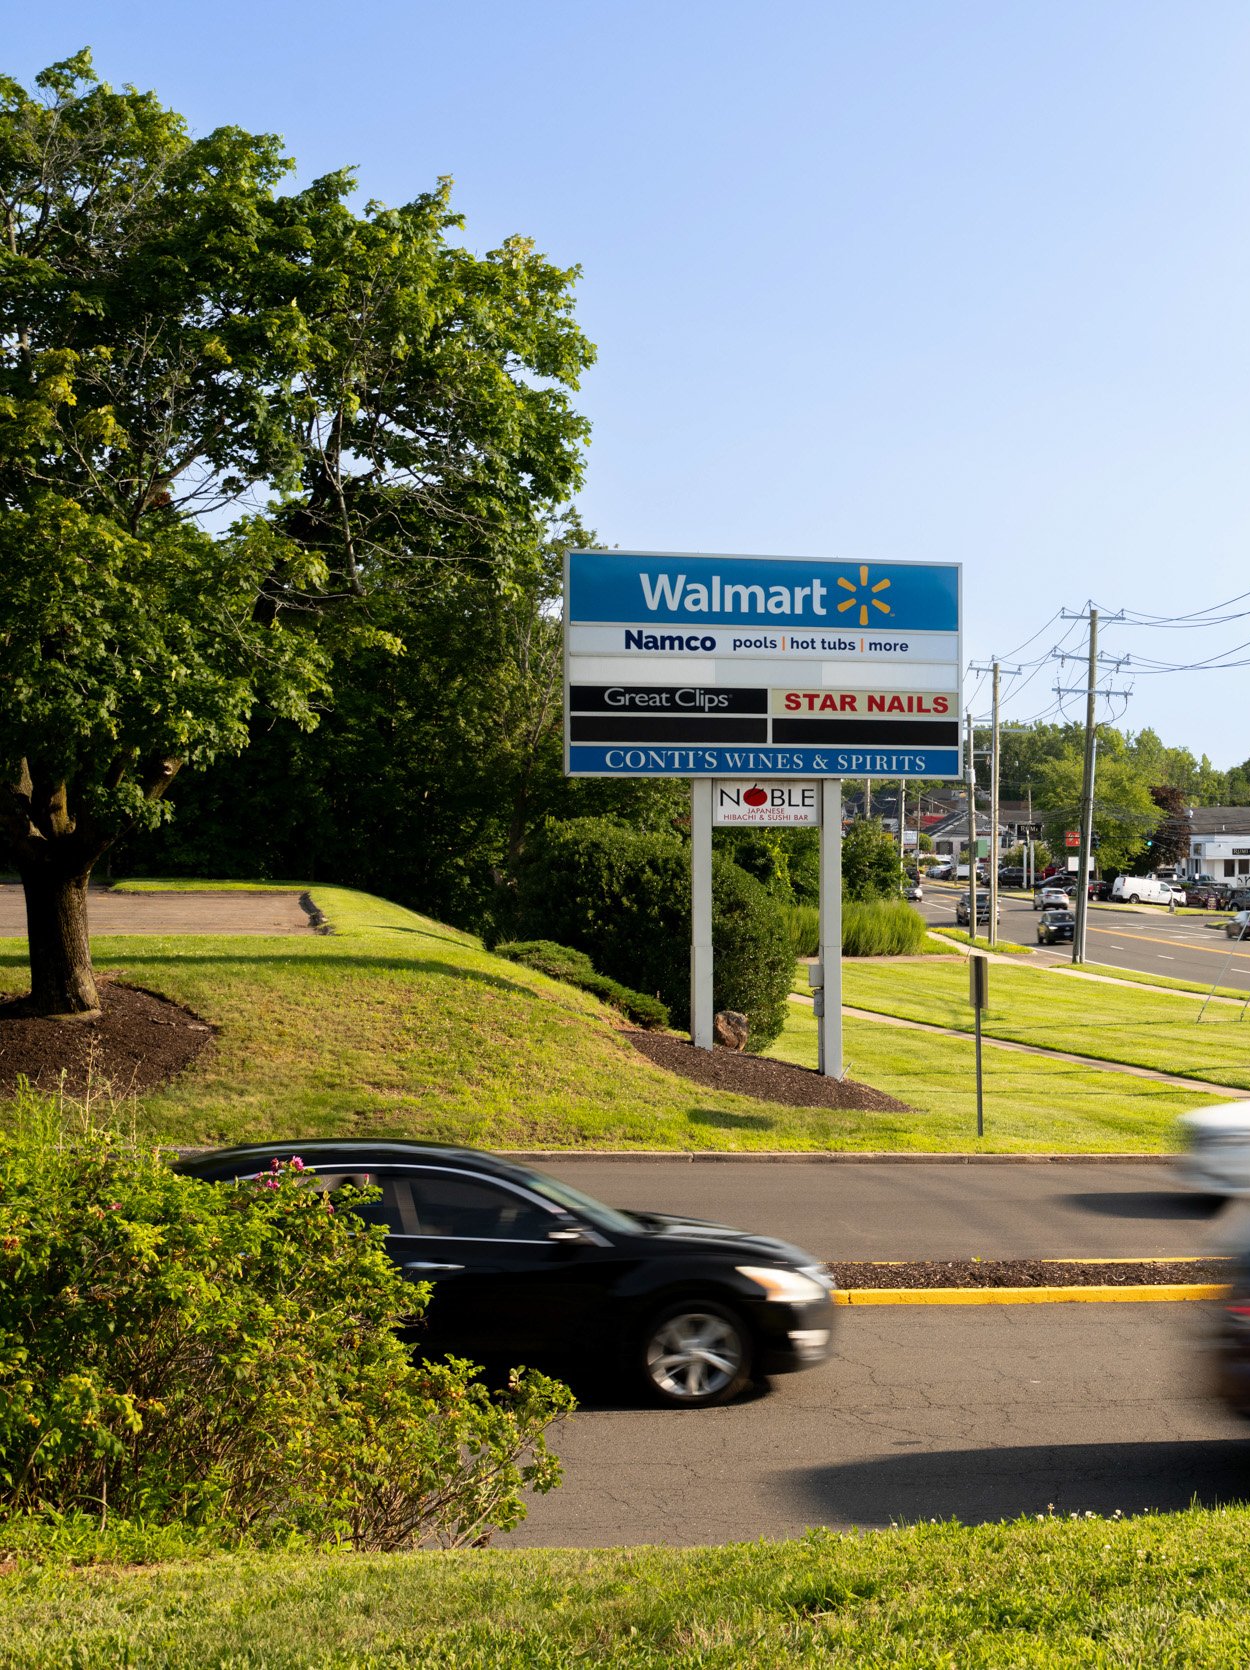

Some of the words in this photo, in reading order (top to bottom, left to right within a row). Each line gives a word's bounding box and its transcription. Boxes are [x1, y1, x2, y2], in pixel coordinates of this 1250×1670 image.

[639, 573, 827, 616] Walmart
[624, 629, 717, 651] Namco
[733, 636, 777, 651] pools
[790, 636, 816, 651] hot
[821, 637, 856, 651] tubs
[869, 641, 909, 652] more
[604, 687, 671, 707] Great
[675, 688, 729, 712] Clips
[784, 693, 858, 712] STAR
[867, 695, 949, 714] NAILS
[605, 750, 718, 769] CONTI'S
[724, 752, 804, 770] WINES
[812, 754, 829, 770] &
[837, 754, 926, 771] SPIRITS
